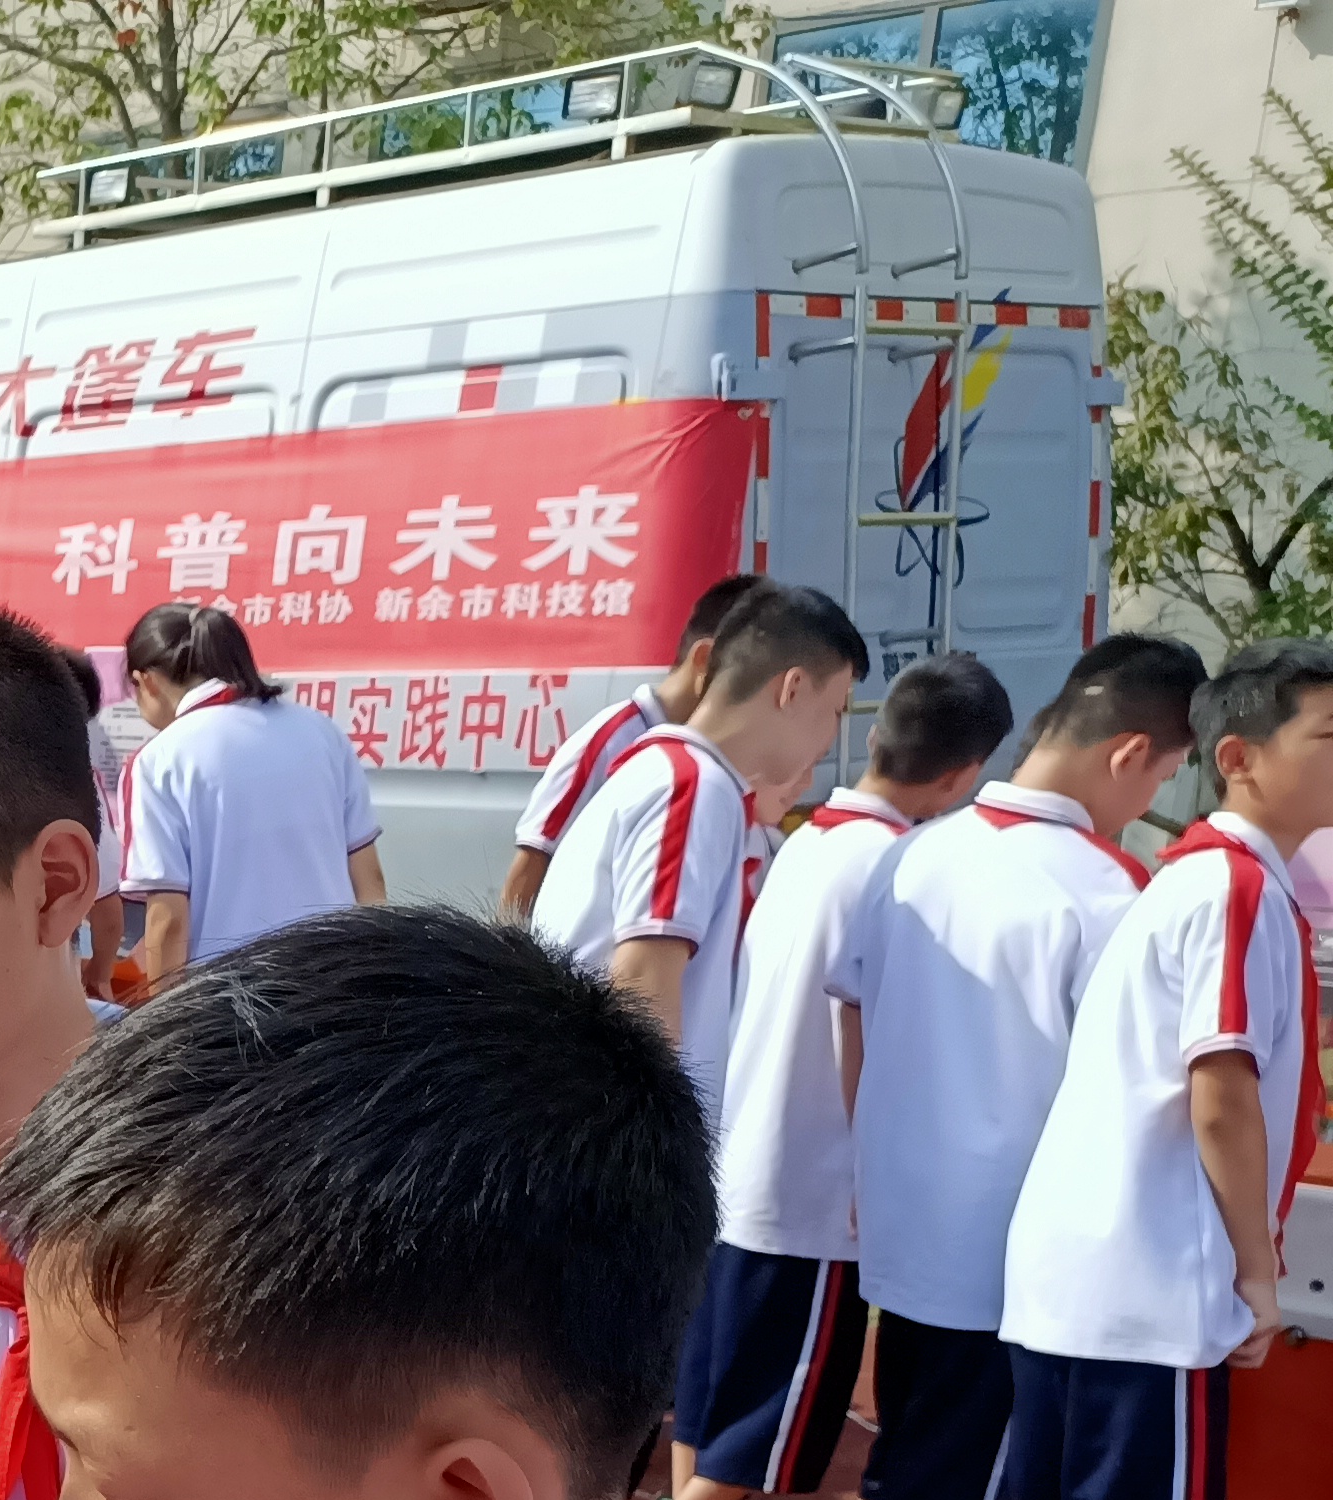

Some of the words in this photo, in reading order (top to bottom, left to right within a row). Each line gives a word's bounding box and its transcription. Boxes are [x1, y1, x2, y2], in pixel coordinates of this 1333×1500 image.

[52, 485, 641, 596] 科普向未来
[374, 579, 637, 623] 新余市科技馆
